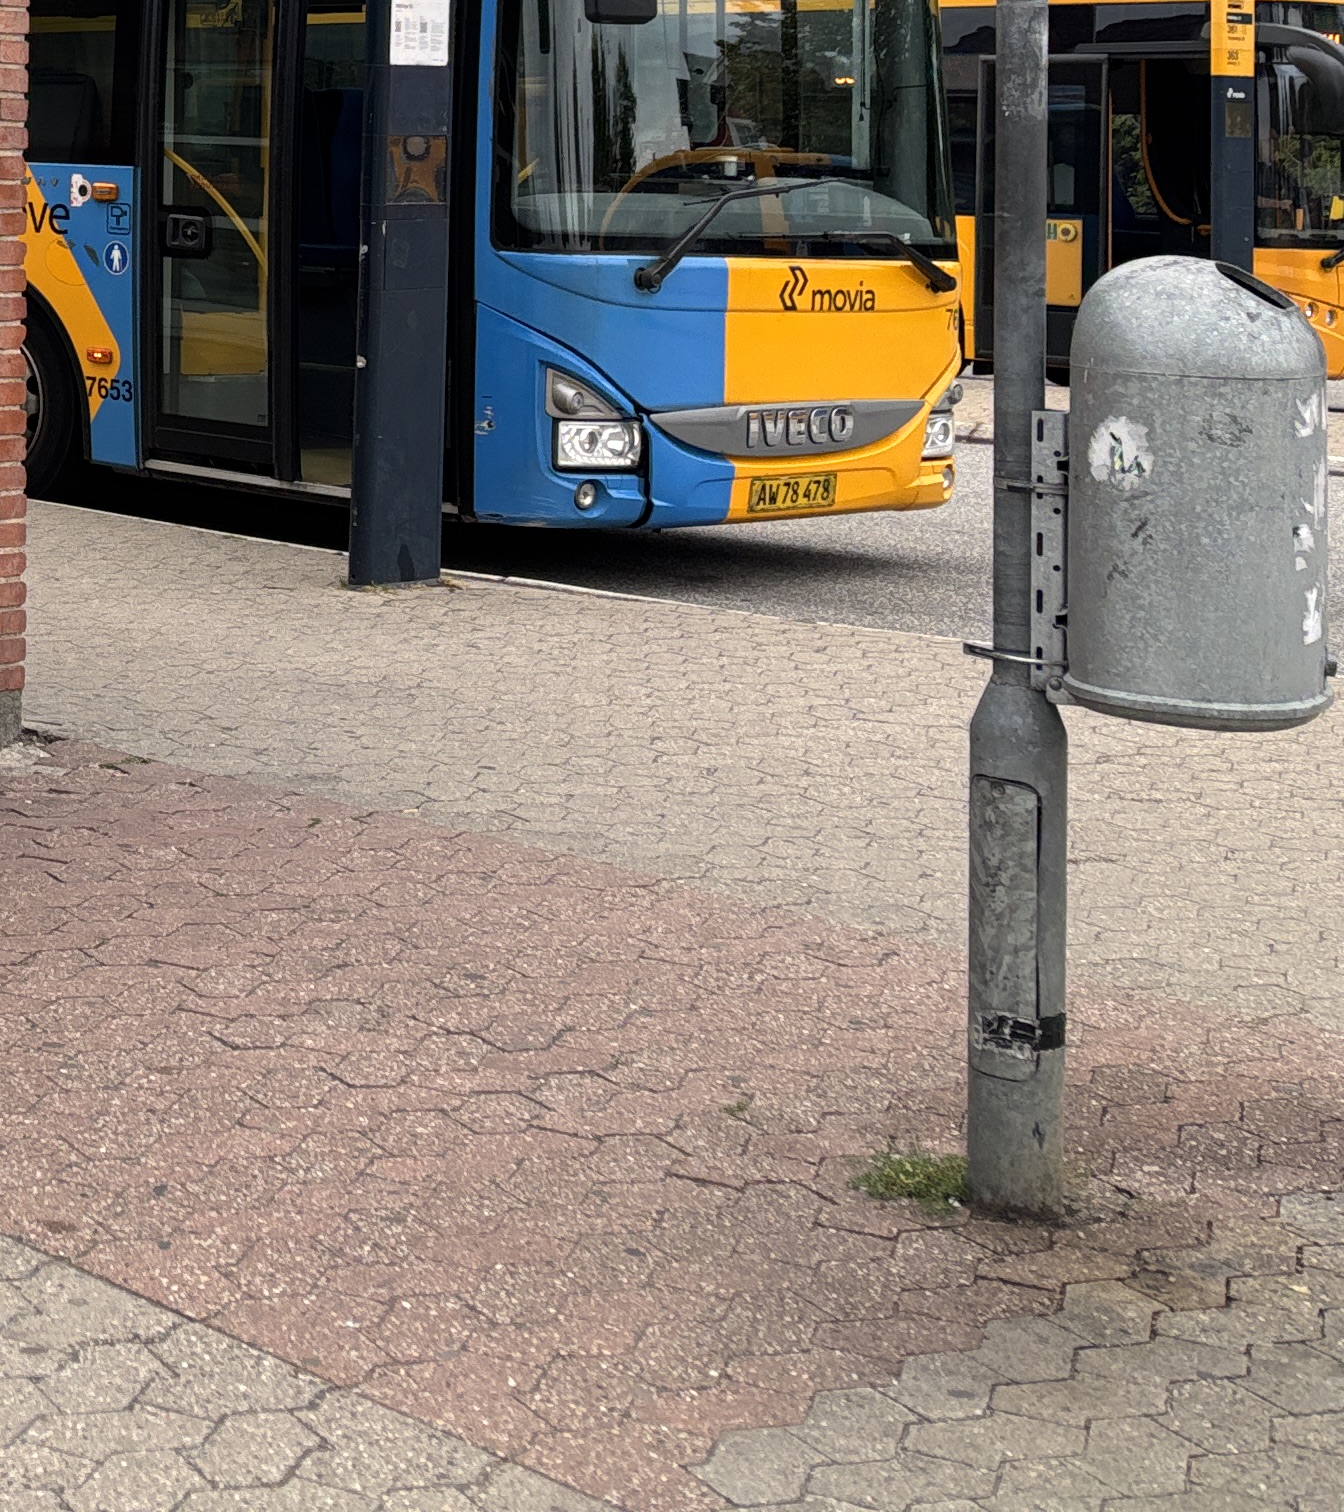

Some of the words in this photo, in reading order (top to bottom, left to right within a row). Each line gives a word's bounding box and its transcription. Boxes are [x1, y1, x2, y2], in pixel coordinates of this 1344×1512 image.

[23, 201, 70, 236] ve
[811, 280, 876, 312] movia
[85, 376, 133, 403] 7653
[746, 408, 855, 449] IVECO
[756, 483, 779, 508] AW
[782, 480, 799, 504] 78
[802, 477, 831, 503] 478
